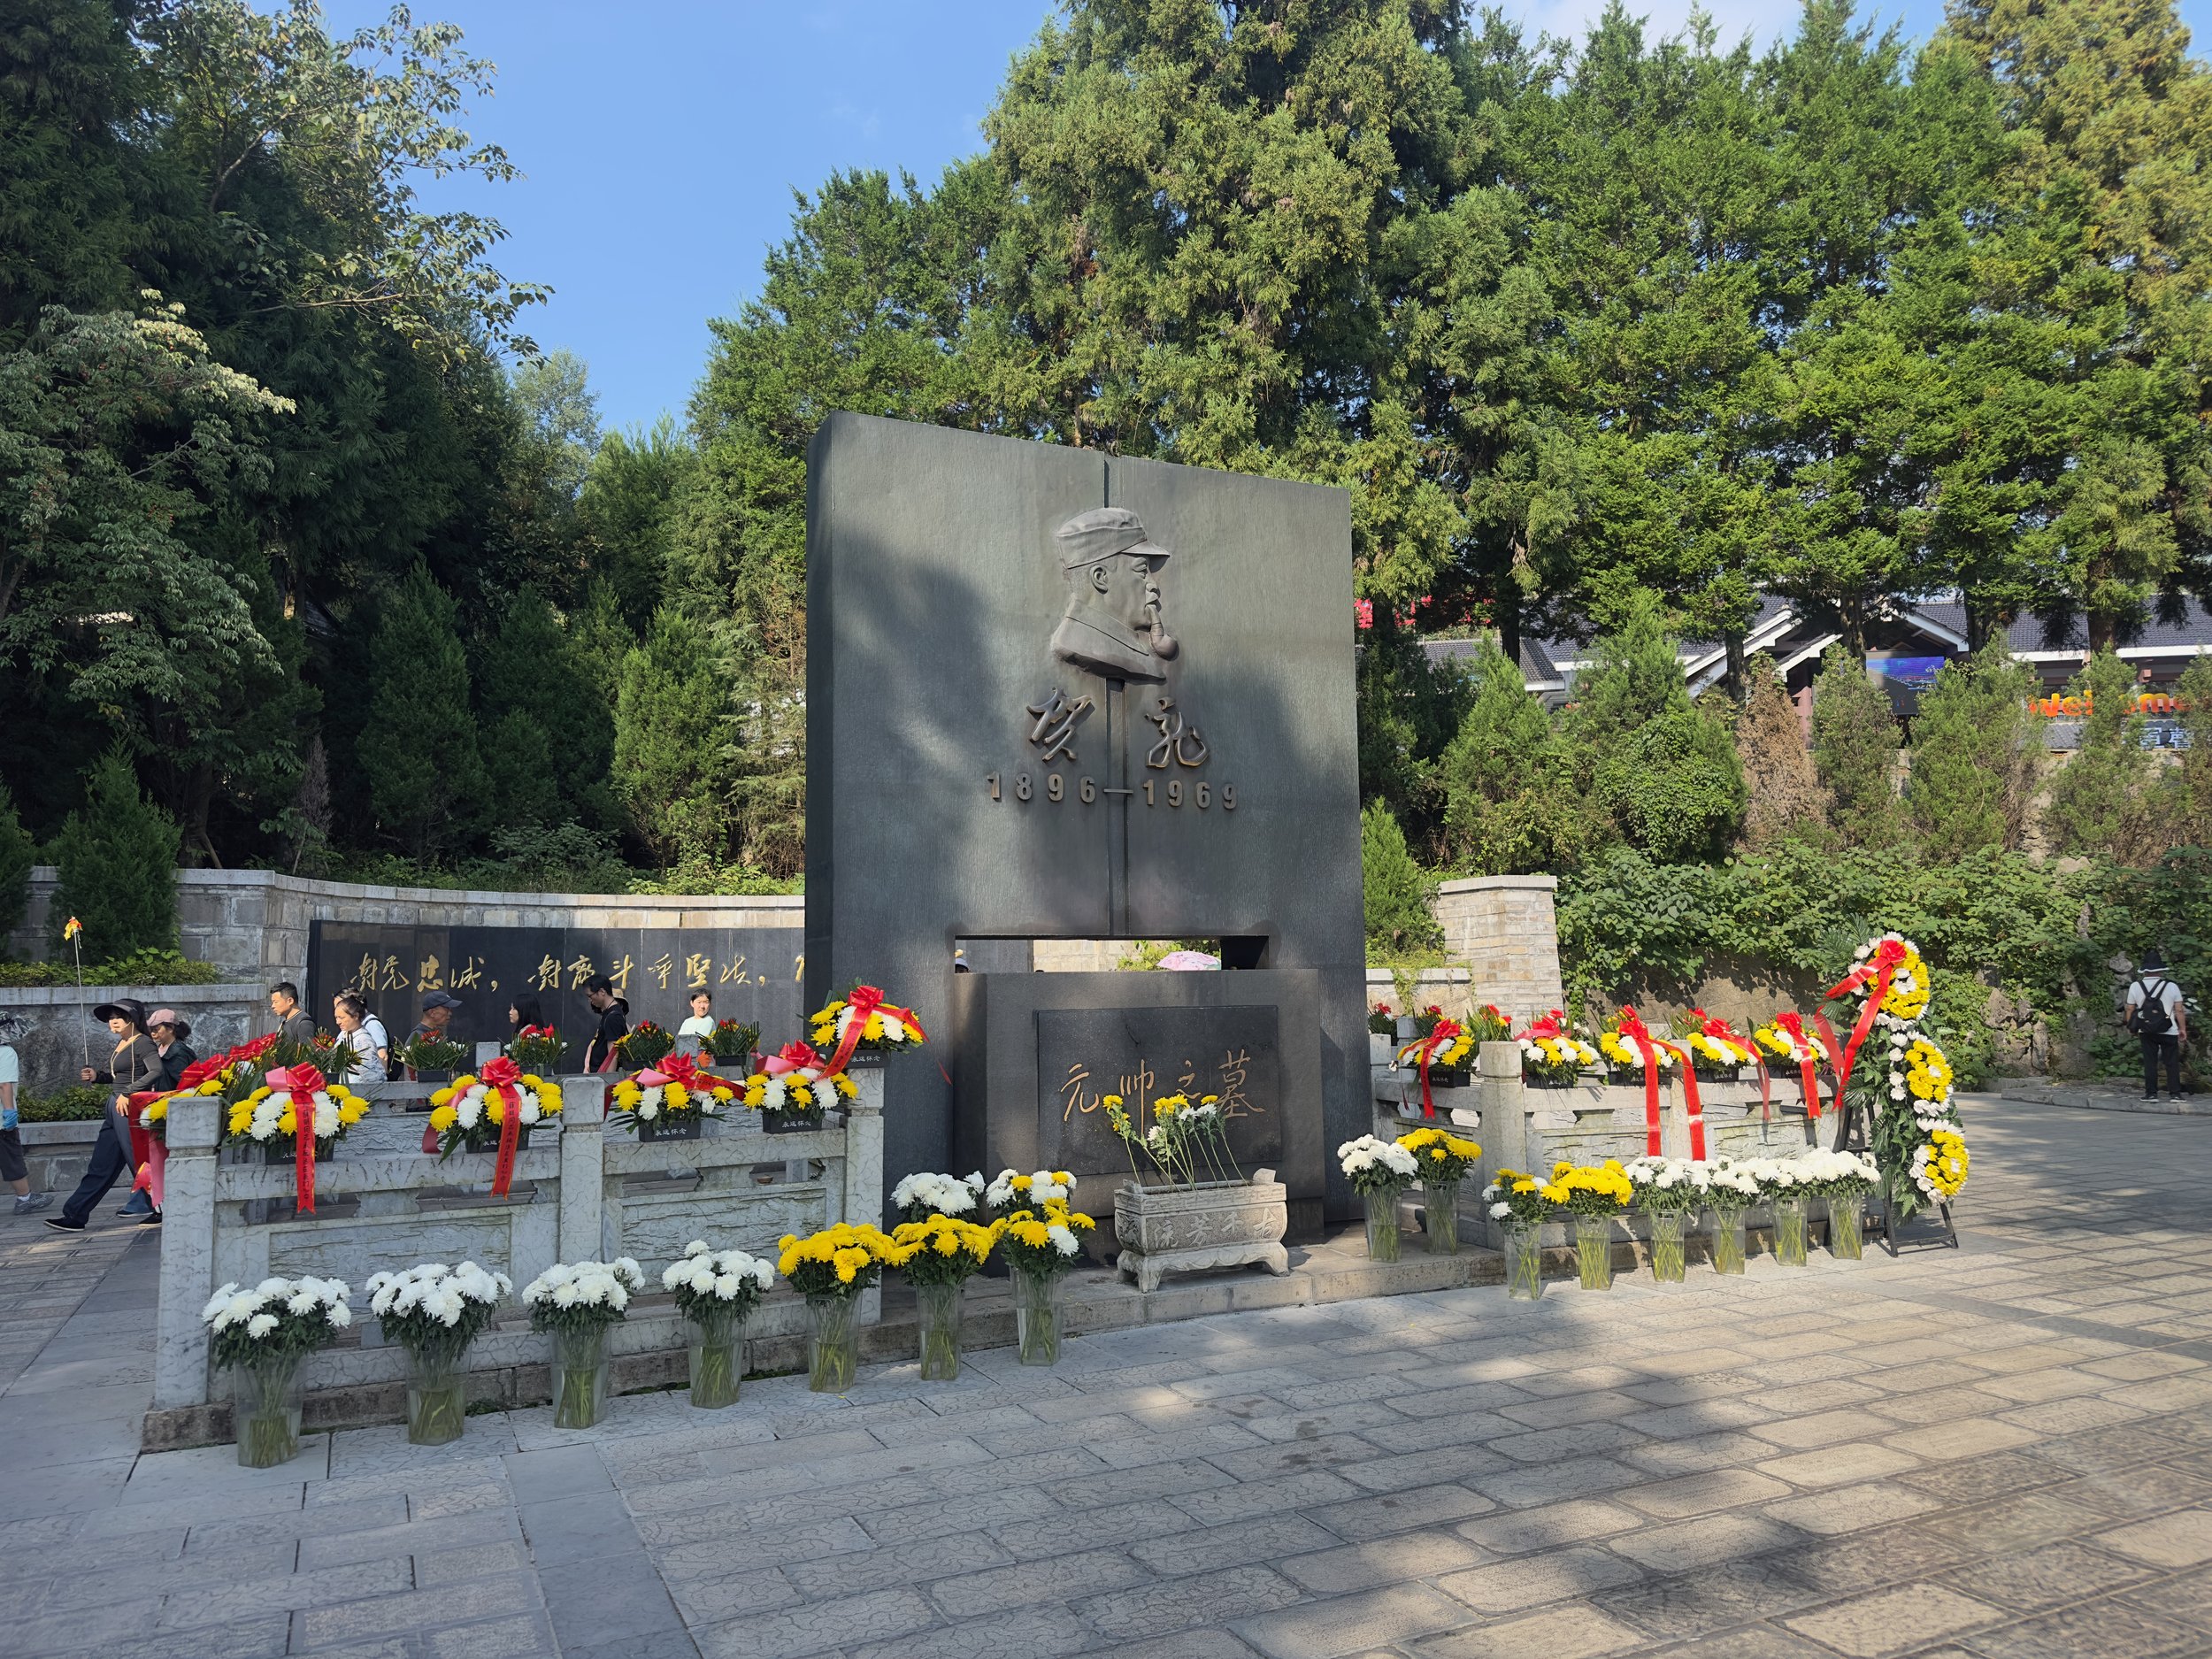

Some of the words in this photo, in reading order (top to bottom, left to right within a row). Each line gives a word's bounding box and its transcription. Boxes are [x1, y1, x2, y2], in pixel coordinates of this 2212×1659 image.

[1060, 1048, 1266, 1138] 元帅之墓
[655, 1127, 687, 1137] 永远怀念
